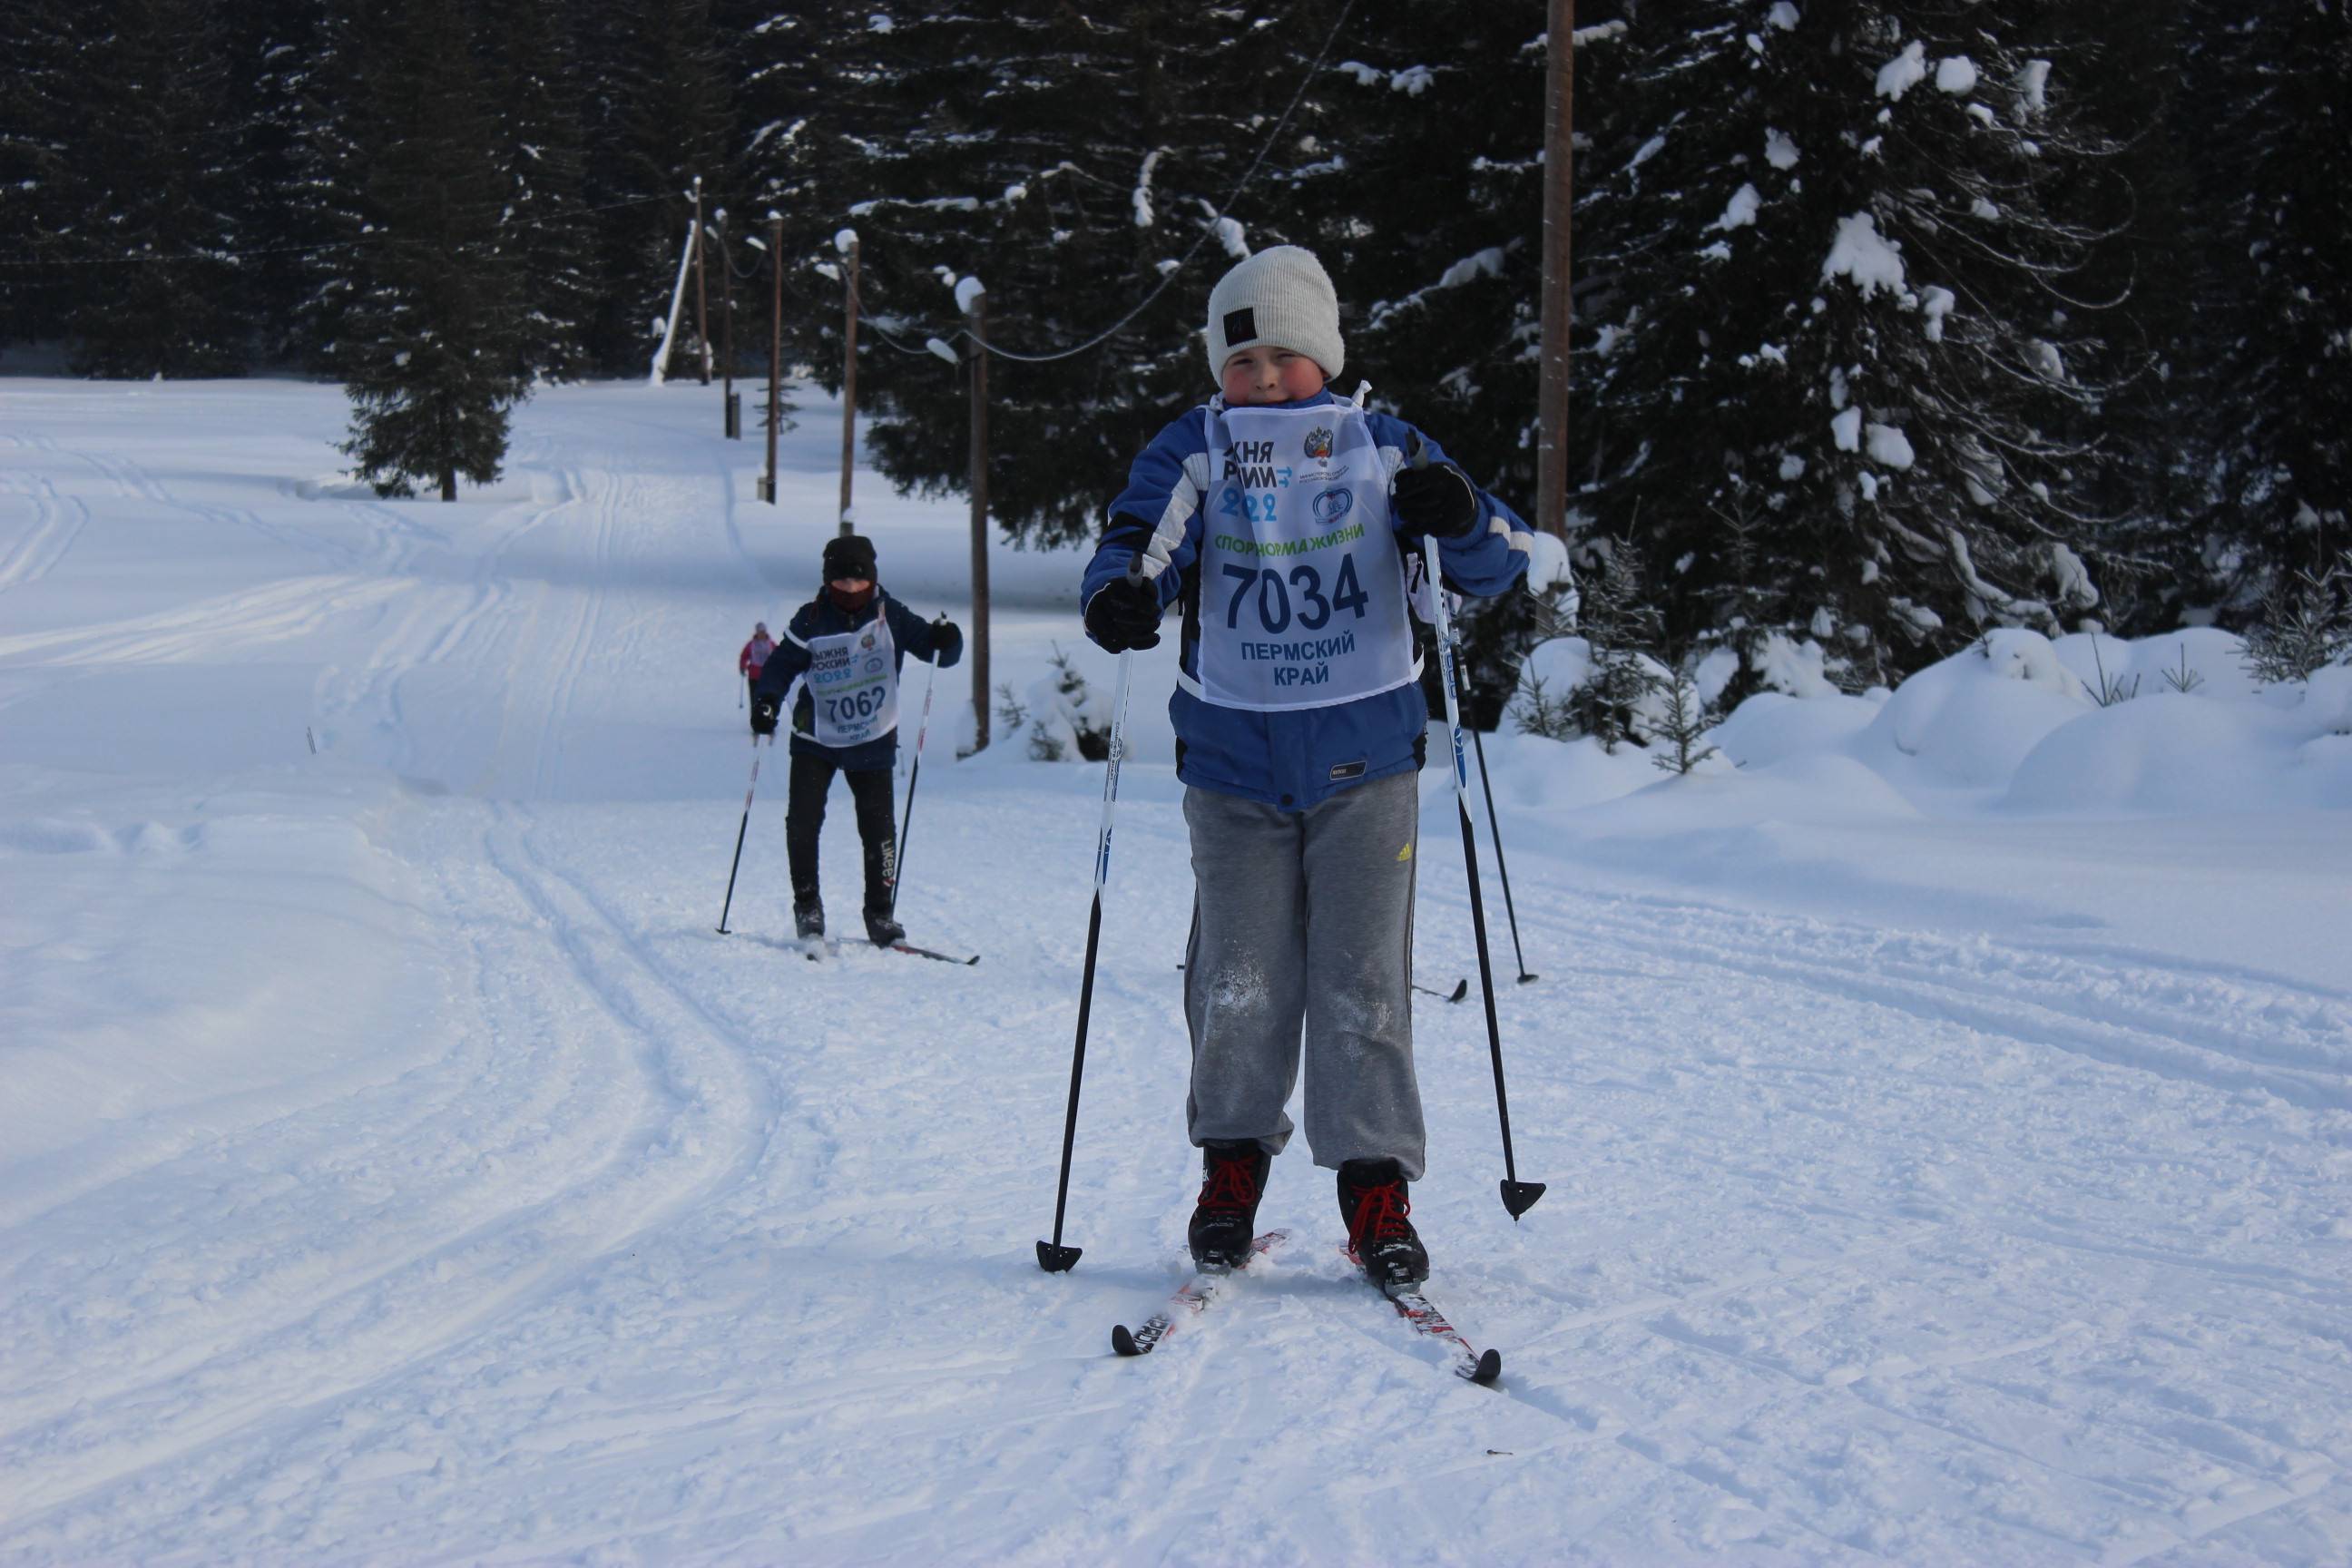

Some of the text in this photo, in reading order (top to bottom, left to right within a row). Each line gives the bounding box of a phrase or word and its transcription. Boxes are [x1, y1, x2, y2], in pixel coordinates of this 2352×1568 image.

[1256, 537, 1308, 559] НОРМА
[1309, 523, 1365, 550] ЖИЗНИ
[1222, 553, 1369, 634] 7034
[1241, 629, 1356, 662] ПЕРМСКИЙ
[815, 668, 851, 683] 2022
[1273, 662, 1329, 686] КРАЙ
[826, 687, 886, 723] 7062
